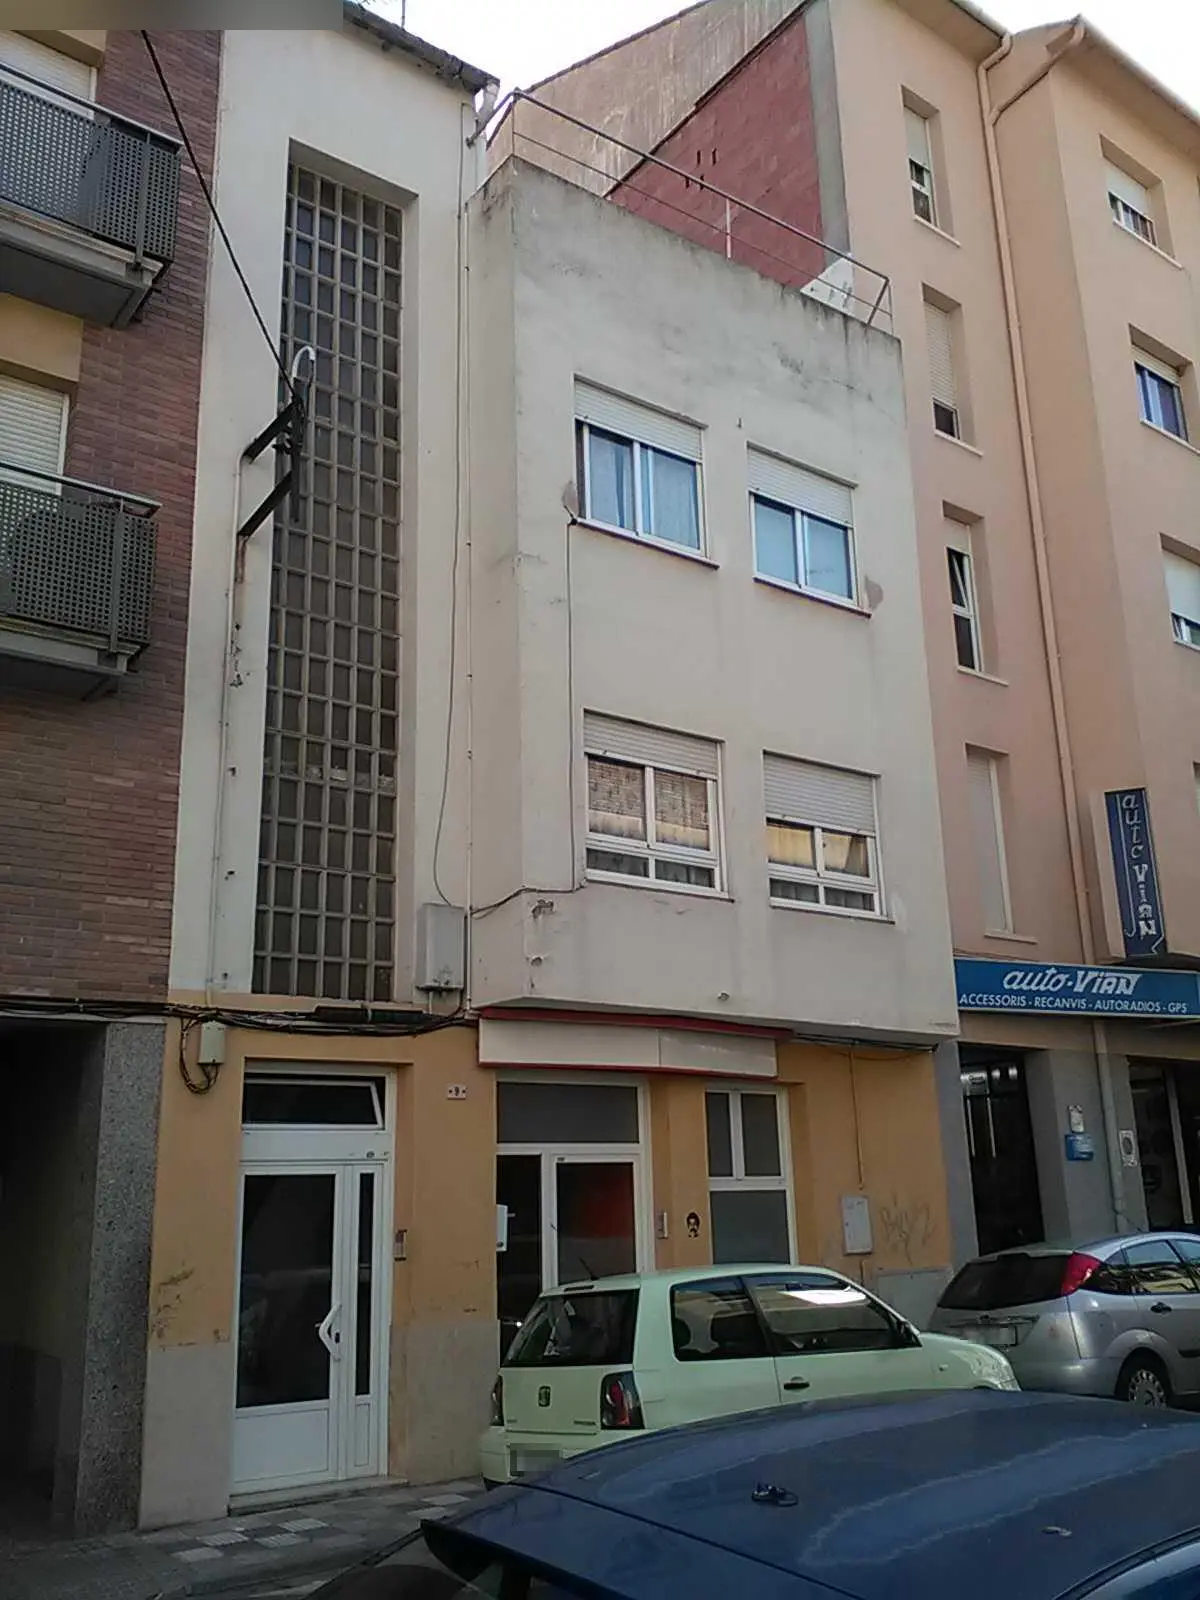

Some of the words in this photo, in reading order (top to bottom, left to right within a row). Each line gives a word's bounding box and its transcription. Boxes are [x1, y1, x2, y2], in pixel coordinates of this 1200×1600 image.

[959, 993, 1027, 1007] ACCESSORIS
[1034, 996, 1087, 1010] RECANVIS
[1094, 1000, 1161, 1013] AUTORADIOS
[1167, 1003, 1188, 1014] GPS
